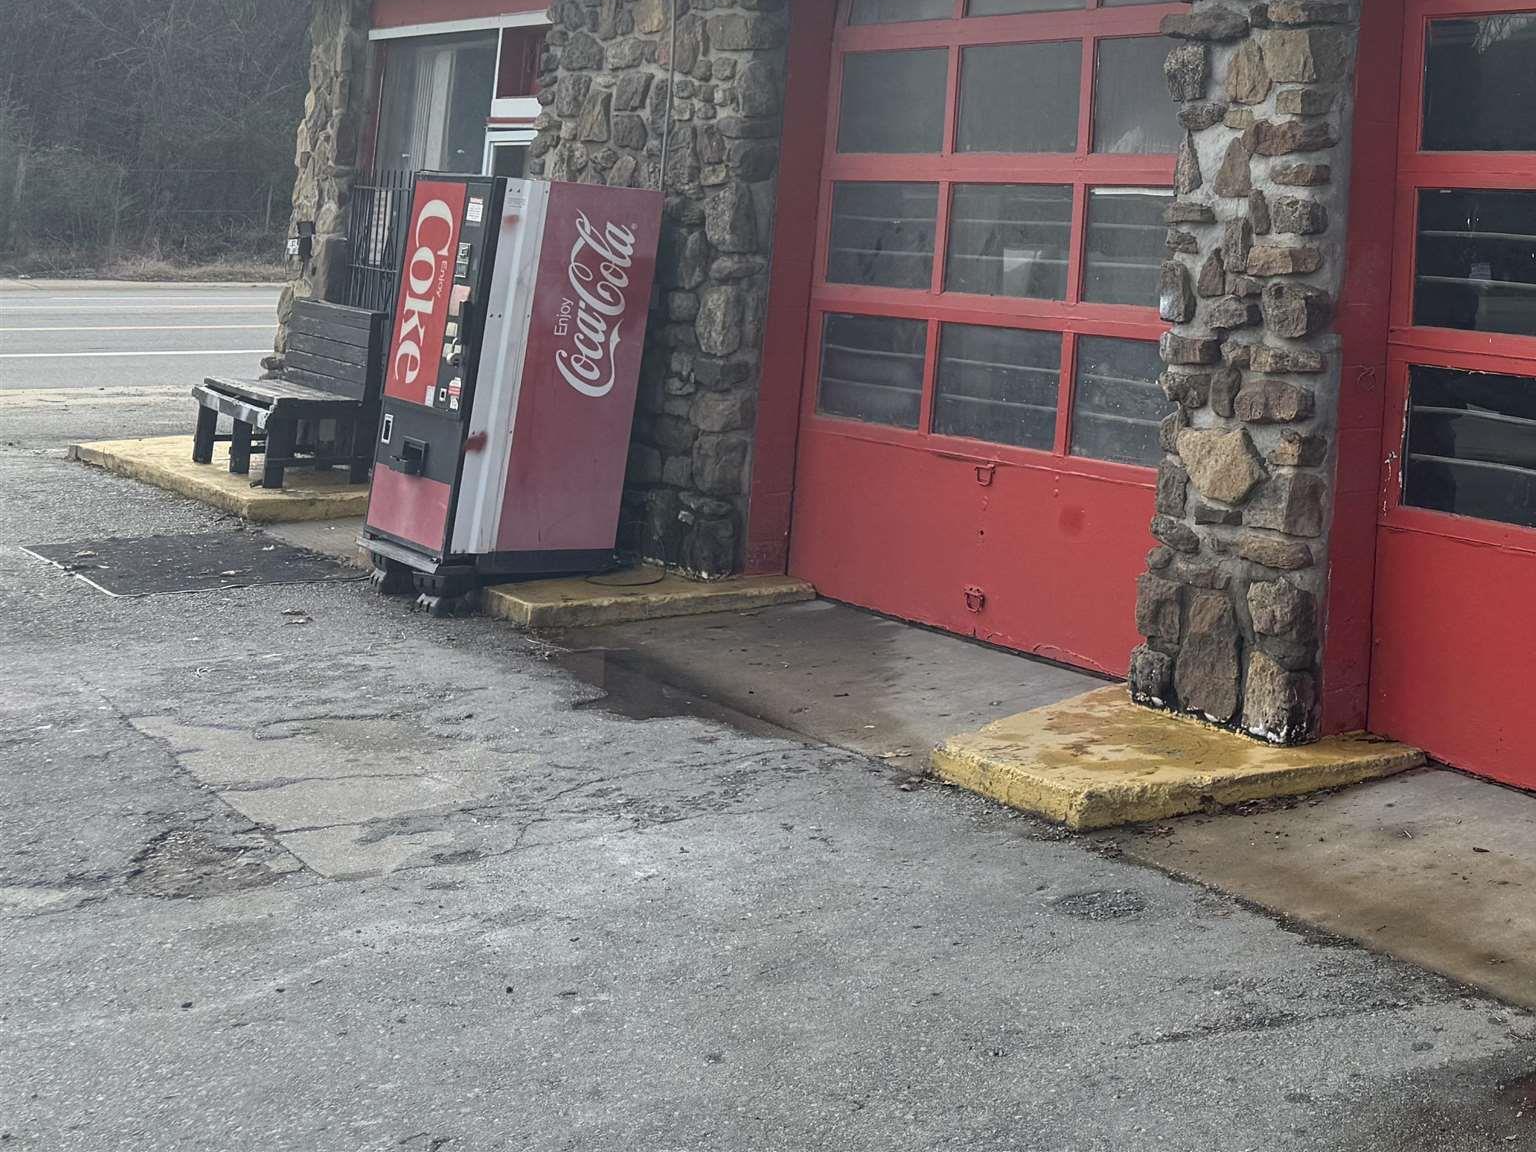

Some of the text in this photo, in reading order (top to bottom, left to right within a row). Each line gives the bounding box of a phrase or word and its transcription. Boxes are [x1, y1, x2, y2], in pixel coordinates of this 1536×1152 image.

[396, 199, 453, 384] Coke
[436, 260, 447, 297] Enjoy
[554, 297, 574, 336] Enjoy
[556, 208, 635, 397] Coca-Cola
